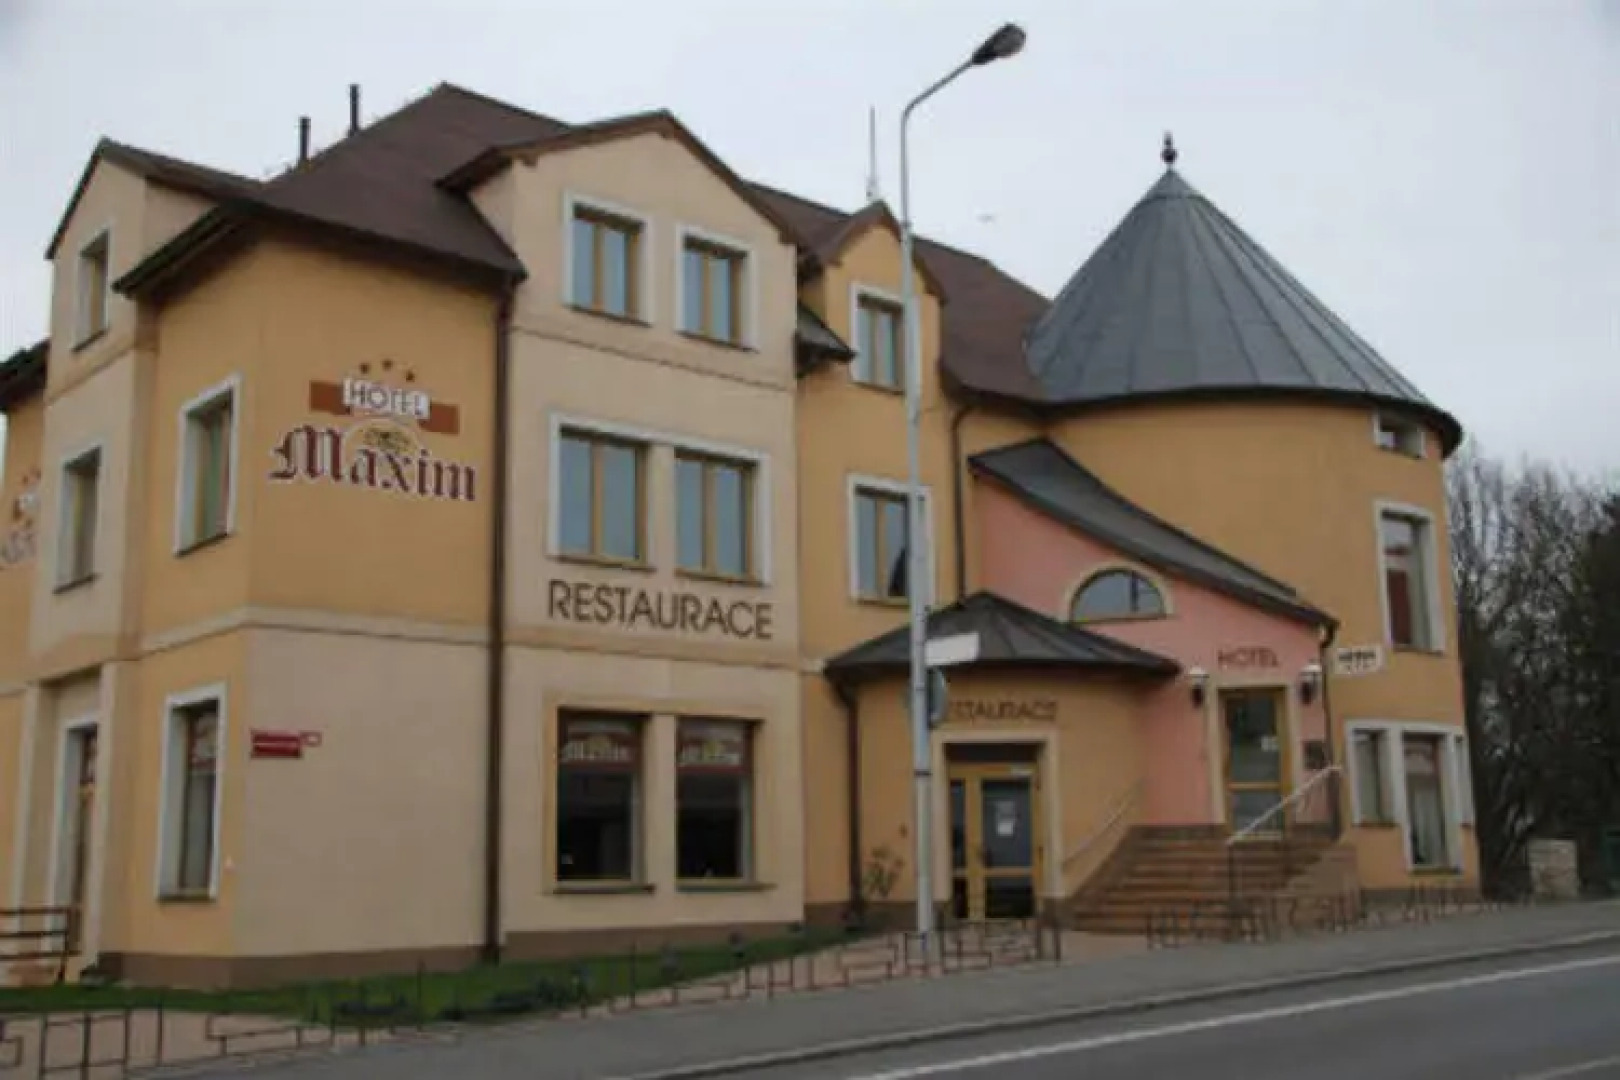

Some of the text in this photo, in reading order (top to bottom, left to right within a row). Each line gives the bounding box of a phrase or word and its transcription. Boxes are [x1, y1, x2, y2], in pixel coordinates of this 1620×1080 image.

[347, 380, 427, 418] HOTEL
[268, 424, 476, 501] Maxim
[548, 578, 773, 640] RESTAURACE
[1217, 648, 1279, 669] HOTEL
